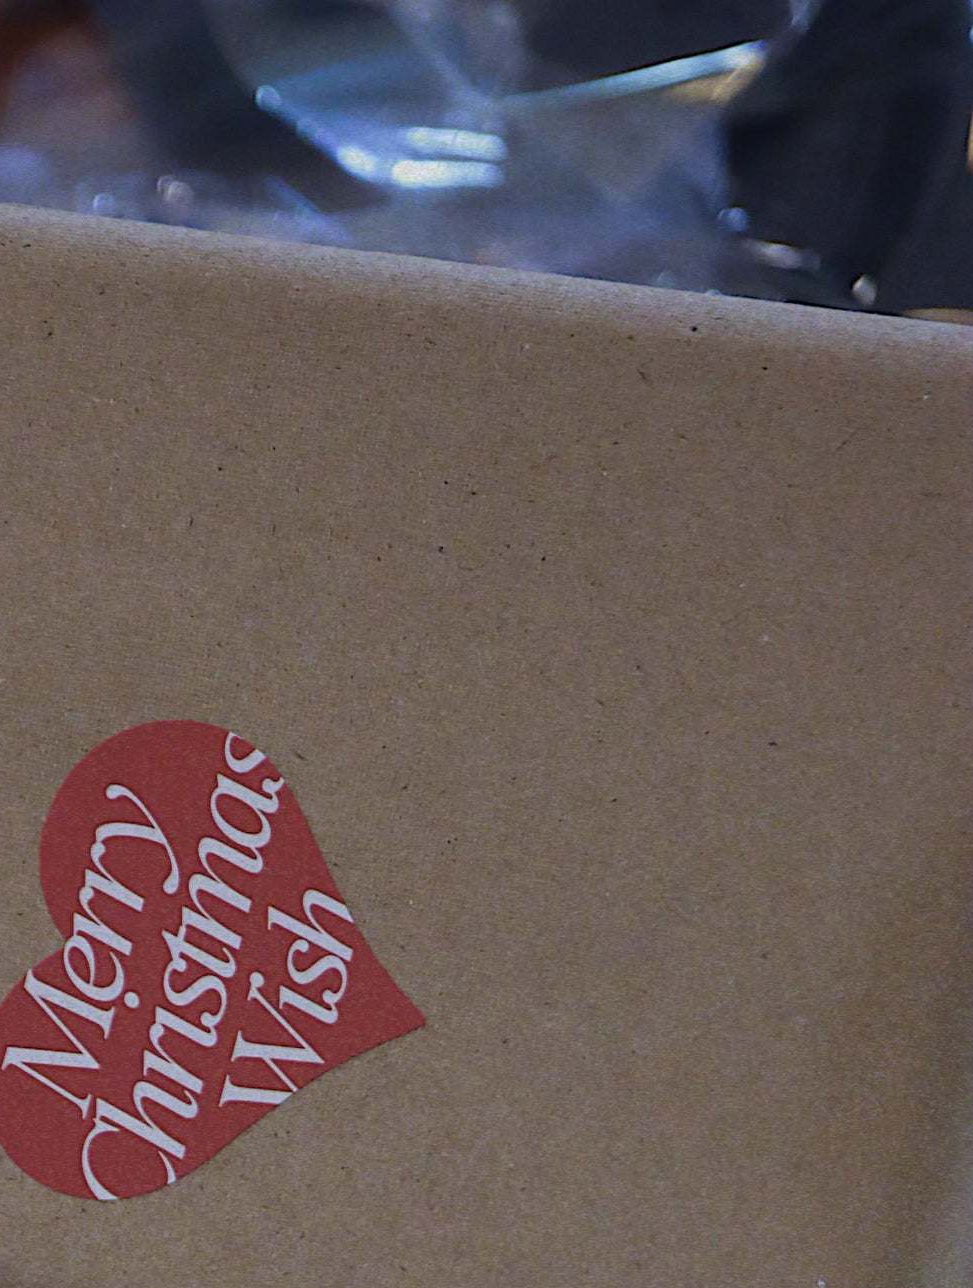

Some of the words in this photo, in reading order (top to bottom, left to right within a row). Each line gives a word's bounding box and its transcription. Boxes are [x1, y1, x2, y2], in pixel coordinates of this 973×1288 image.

[1, 784, 180, 1119] Merry
[81, 731, 286, 1201] Christmas
[219, 889, 355, 1107] Wish
